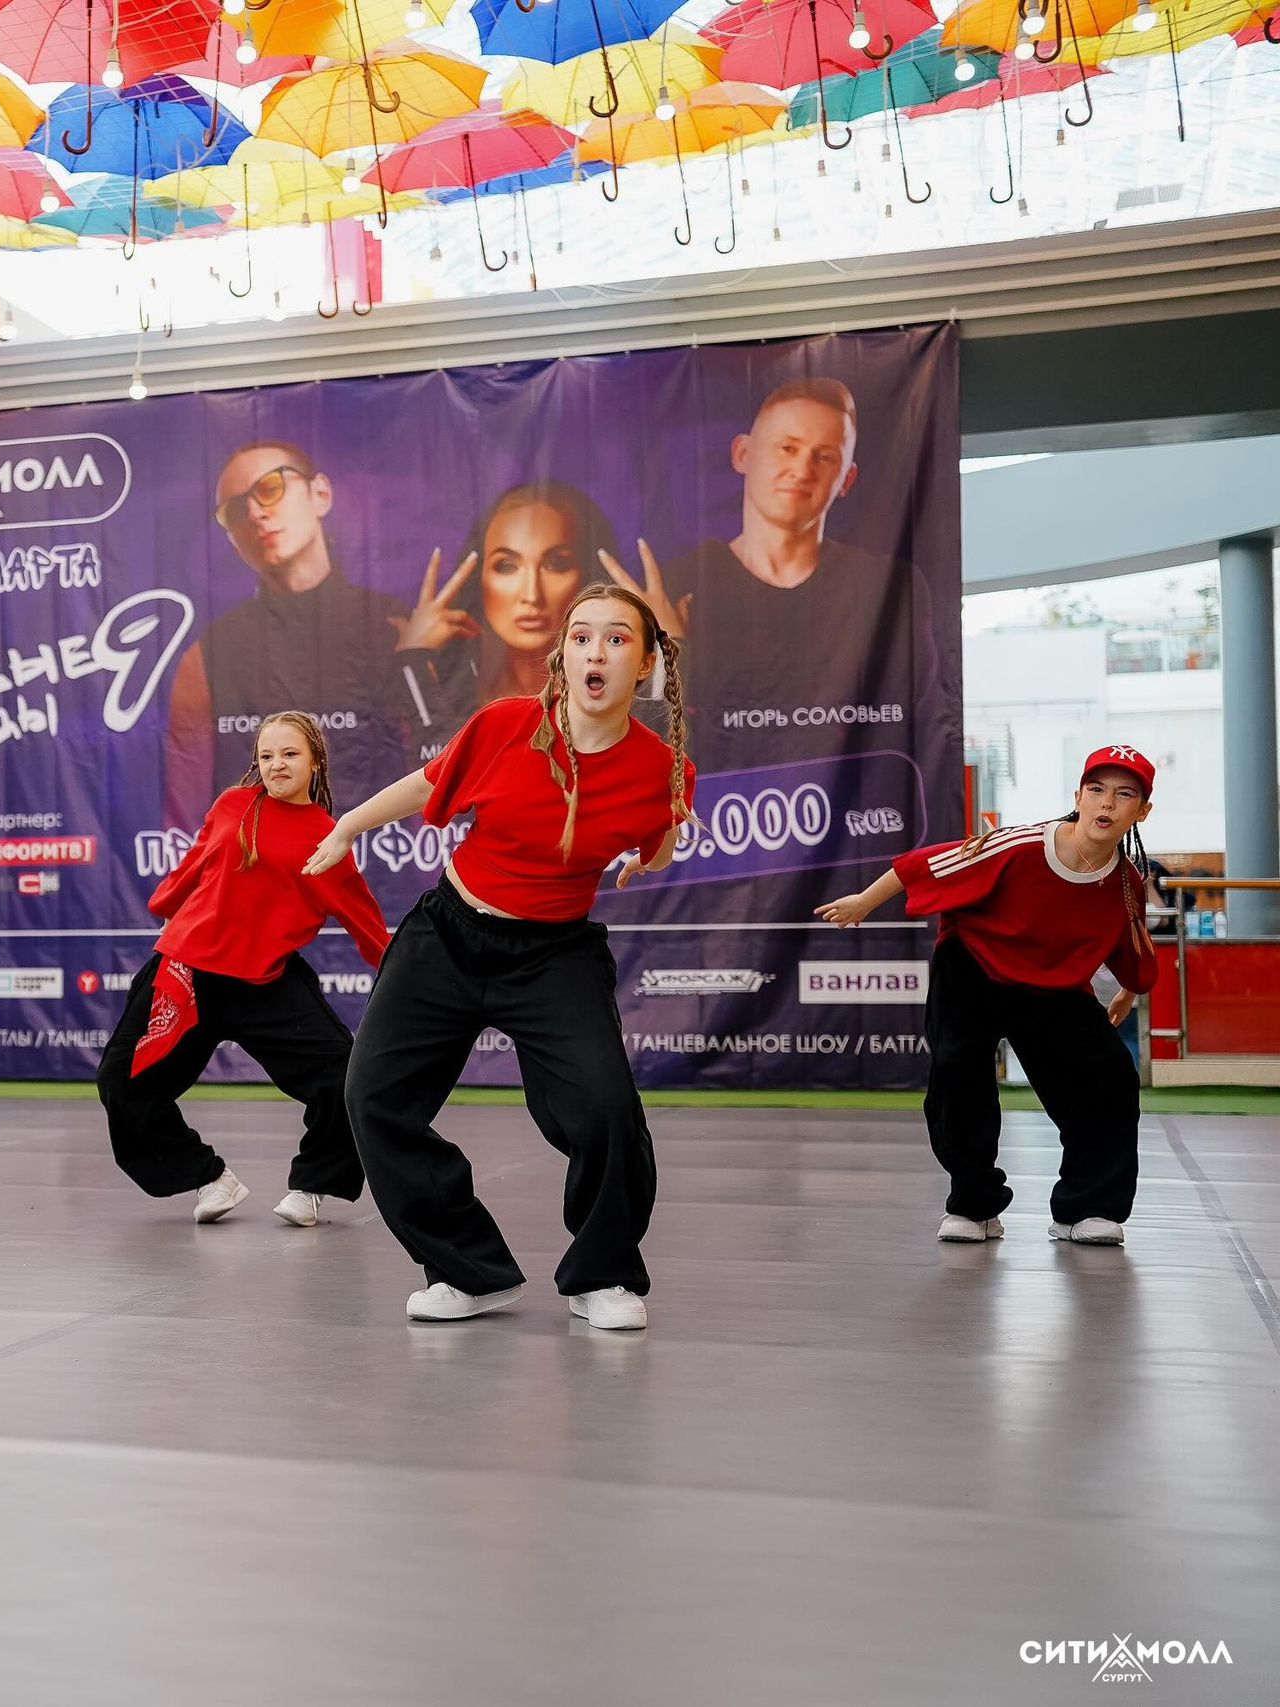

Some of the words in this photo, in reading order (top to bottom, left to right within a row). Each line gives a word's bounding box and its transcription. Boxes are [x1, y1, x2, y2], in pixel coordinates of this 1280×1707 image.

[218, 715, 261, 733] ЕГОР
[723, 707, 789, 728] ИГОРЬ
[792, 703, 904, 726] СОЛОВЬЕВ
[809, 973, 920, 991] ванлав
[631, 1033, 792, 1055] ТАНЦЕВАЛЬНОЕ
[796, 1033, 850, 1054] ШОУ
